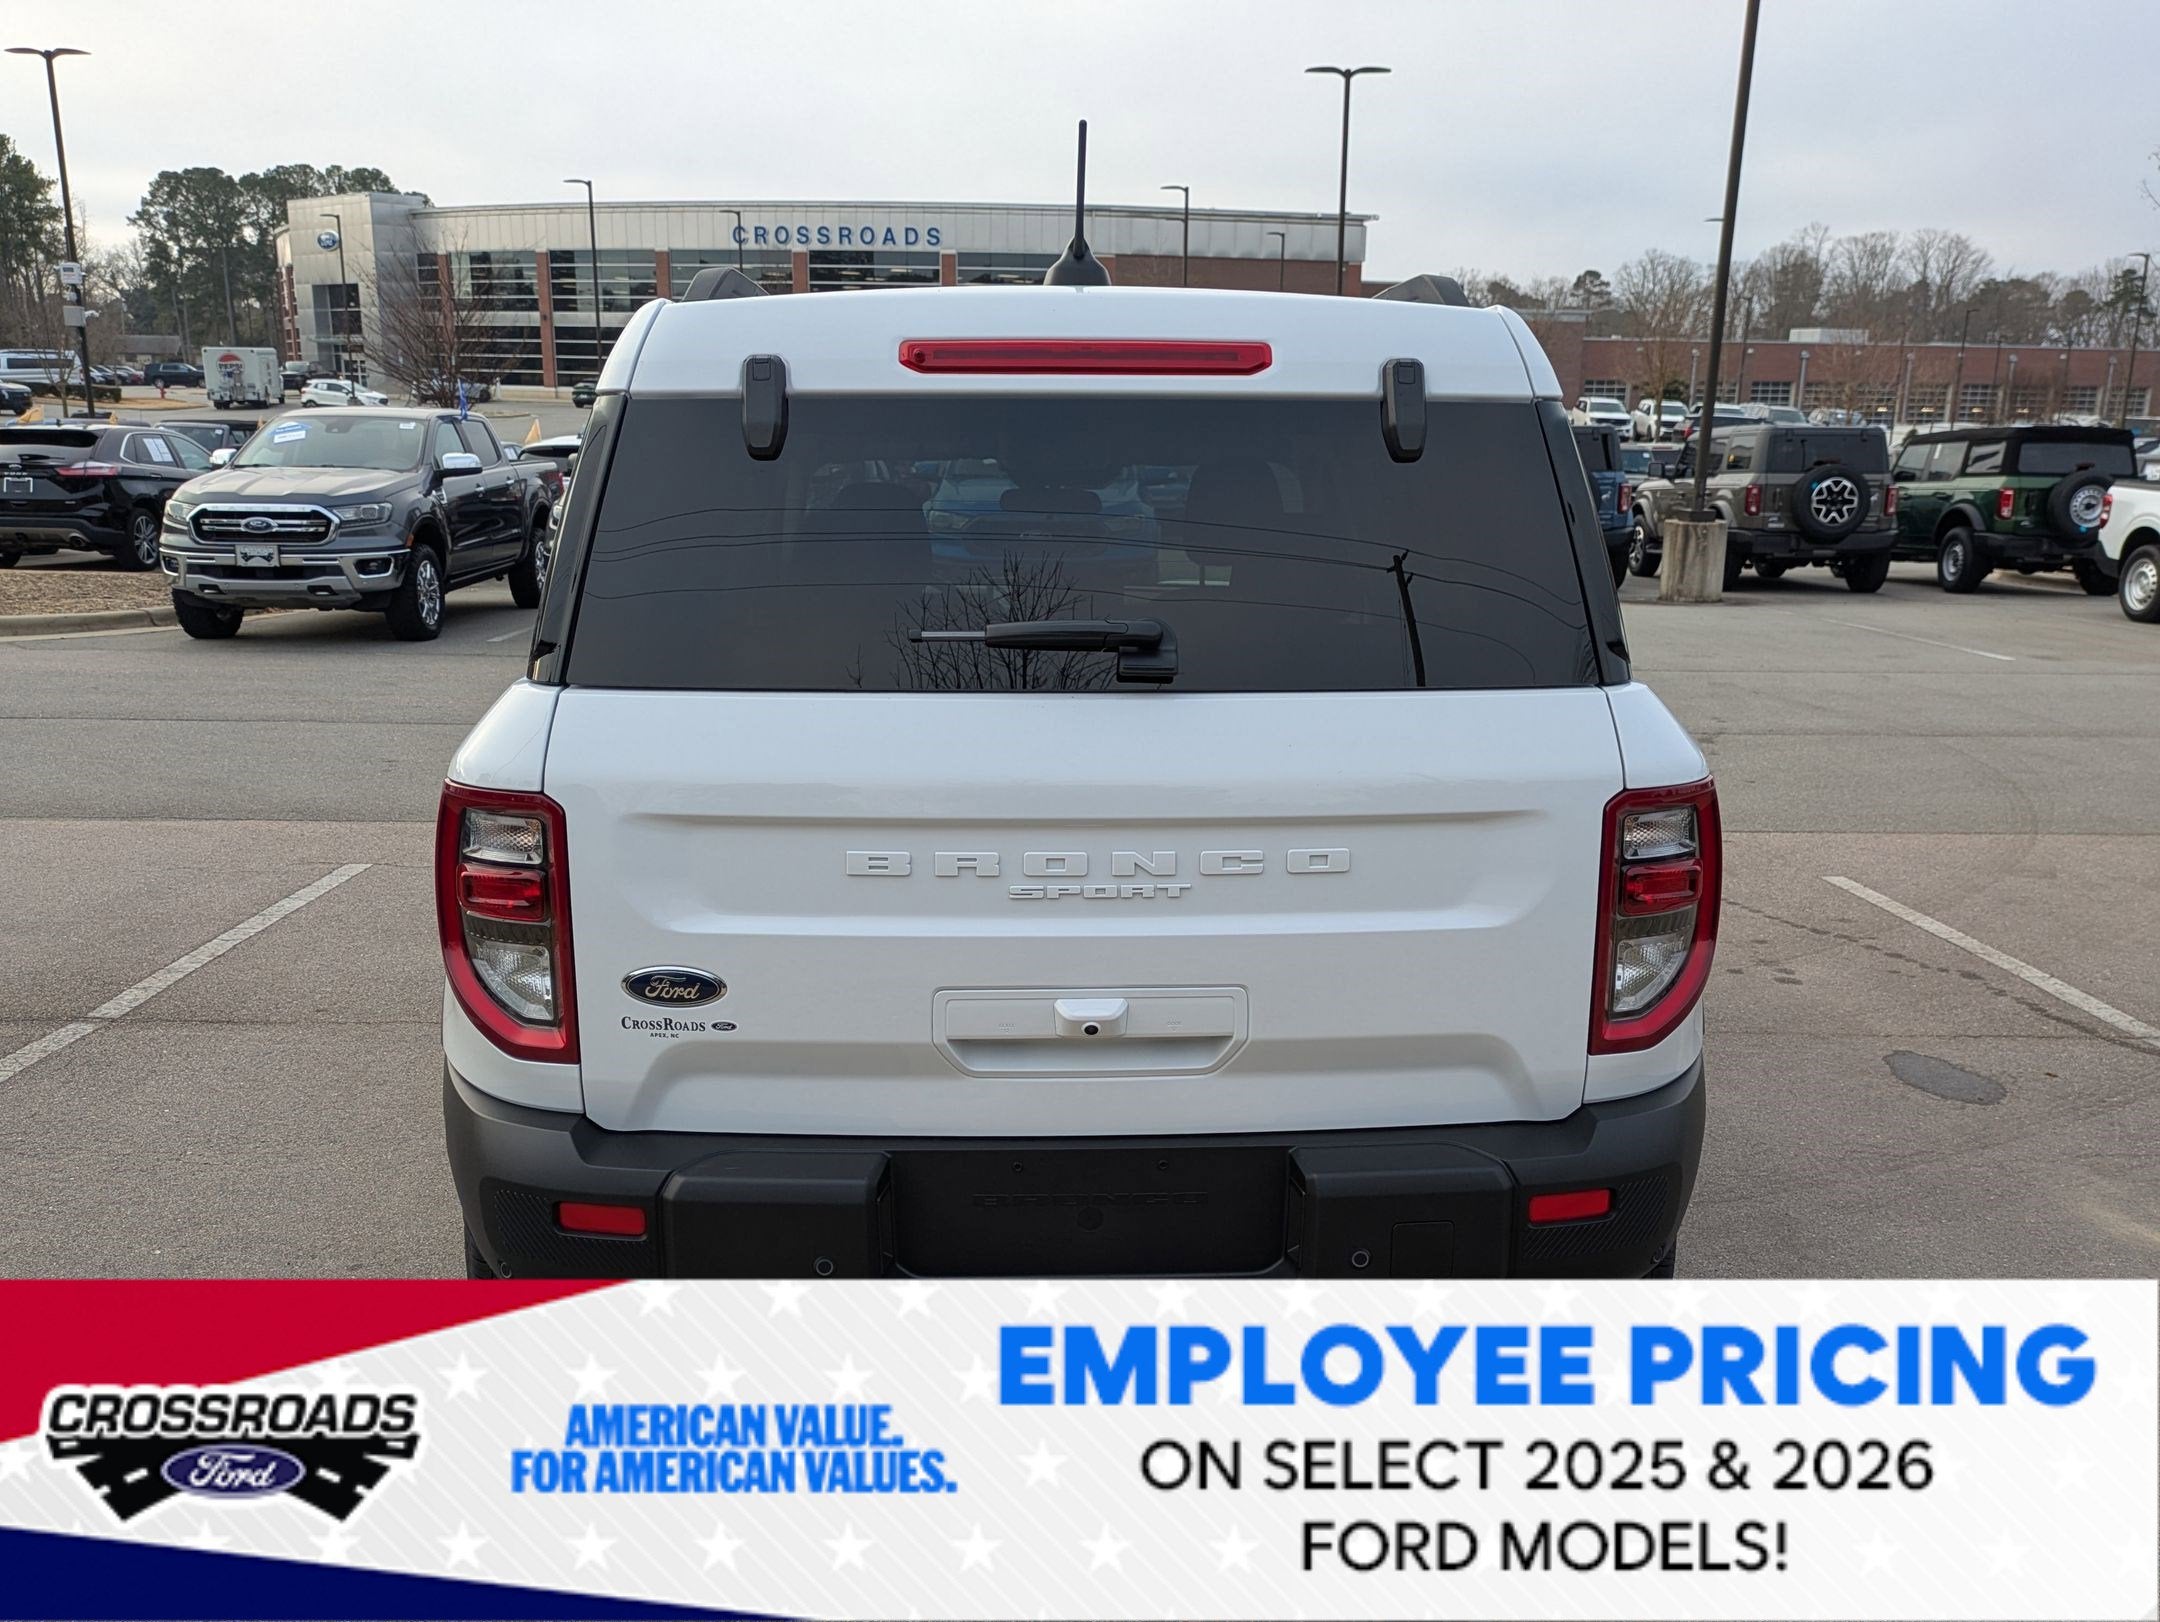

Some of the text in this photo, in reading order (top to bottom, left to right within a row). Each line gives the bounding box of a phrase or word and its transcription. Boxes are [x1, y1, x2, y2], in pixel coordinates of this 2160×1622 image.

[732, 226, 941, 246] CROSSROADS
[846, 848, 1351, 877] BRONCO
[1008, 883, 1192, 900] SPORT
[645, 975, 701, 999] Ford
